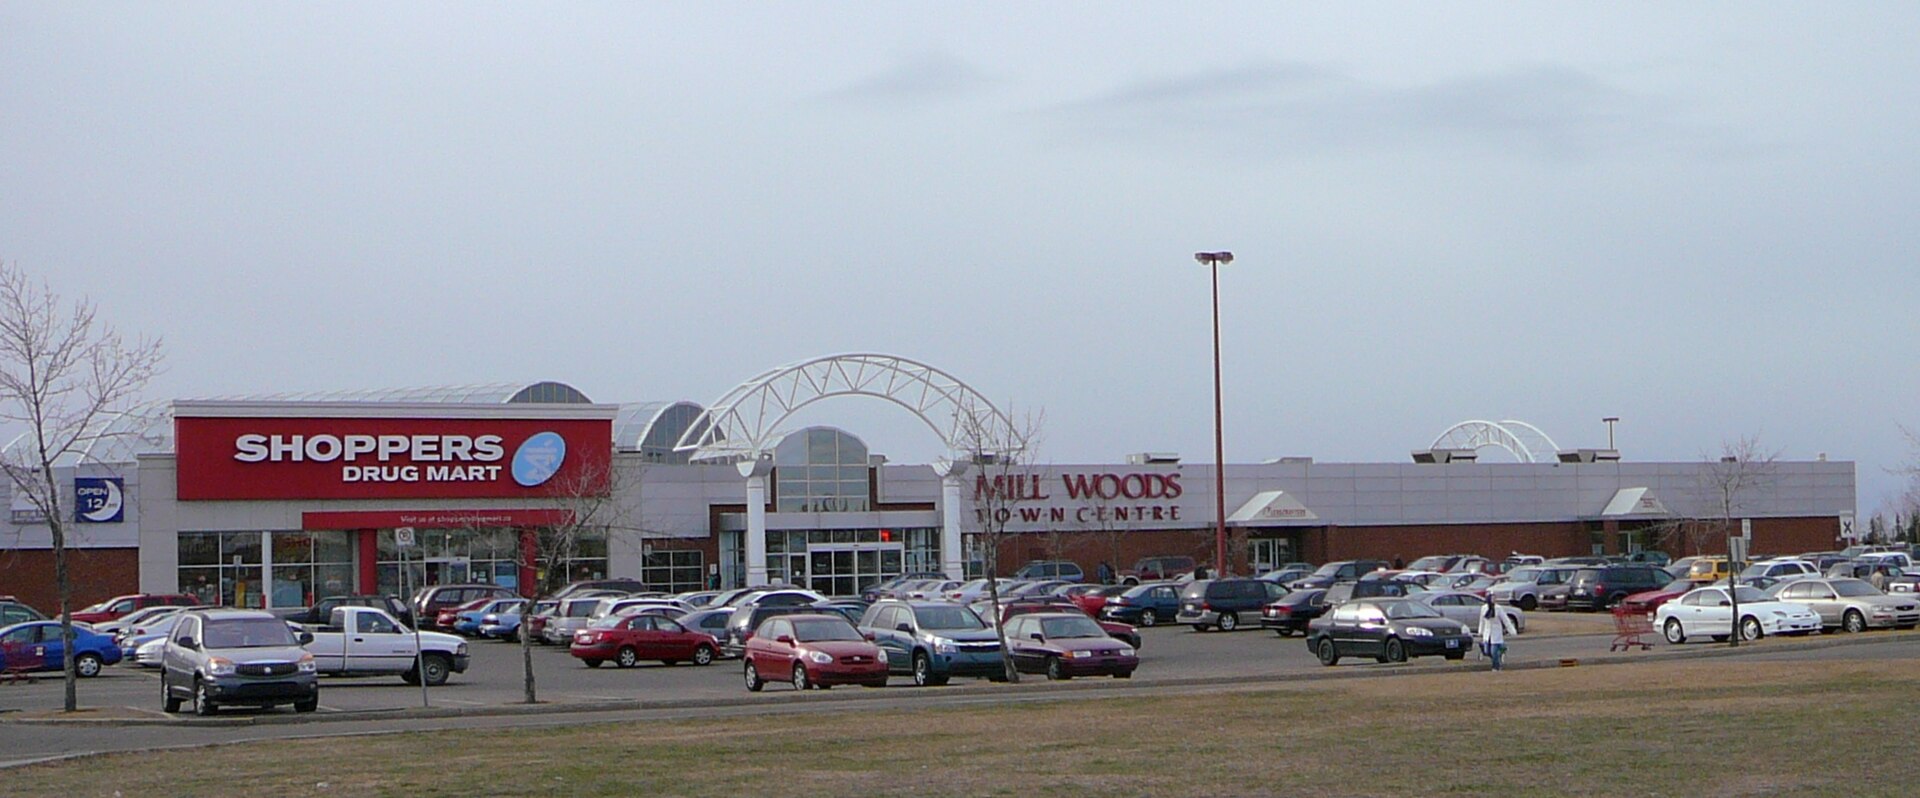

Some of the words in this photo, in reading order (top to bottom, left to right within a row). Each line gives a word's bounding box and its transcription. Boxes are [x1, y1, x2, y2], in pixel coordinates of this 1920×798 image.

[234, 434, 504, 462] SHOPPERS
[342, 466, 418, 482] DRUG
[426, 466, 502, 482] MART
[78, 487, 107, 496] OPEN
[975, 474, 1049, 500] MILL
[1062, 473, 1183, 500] WOODS
